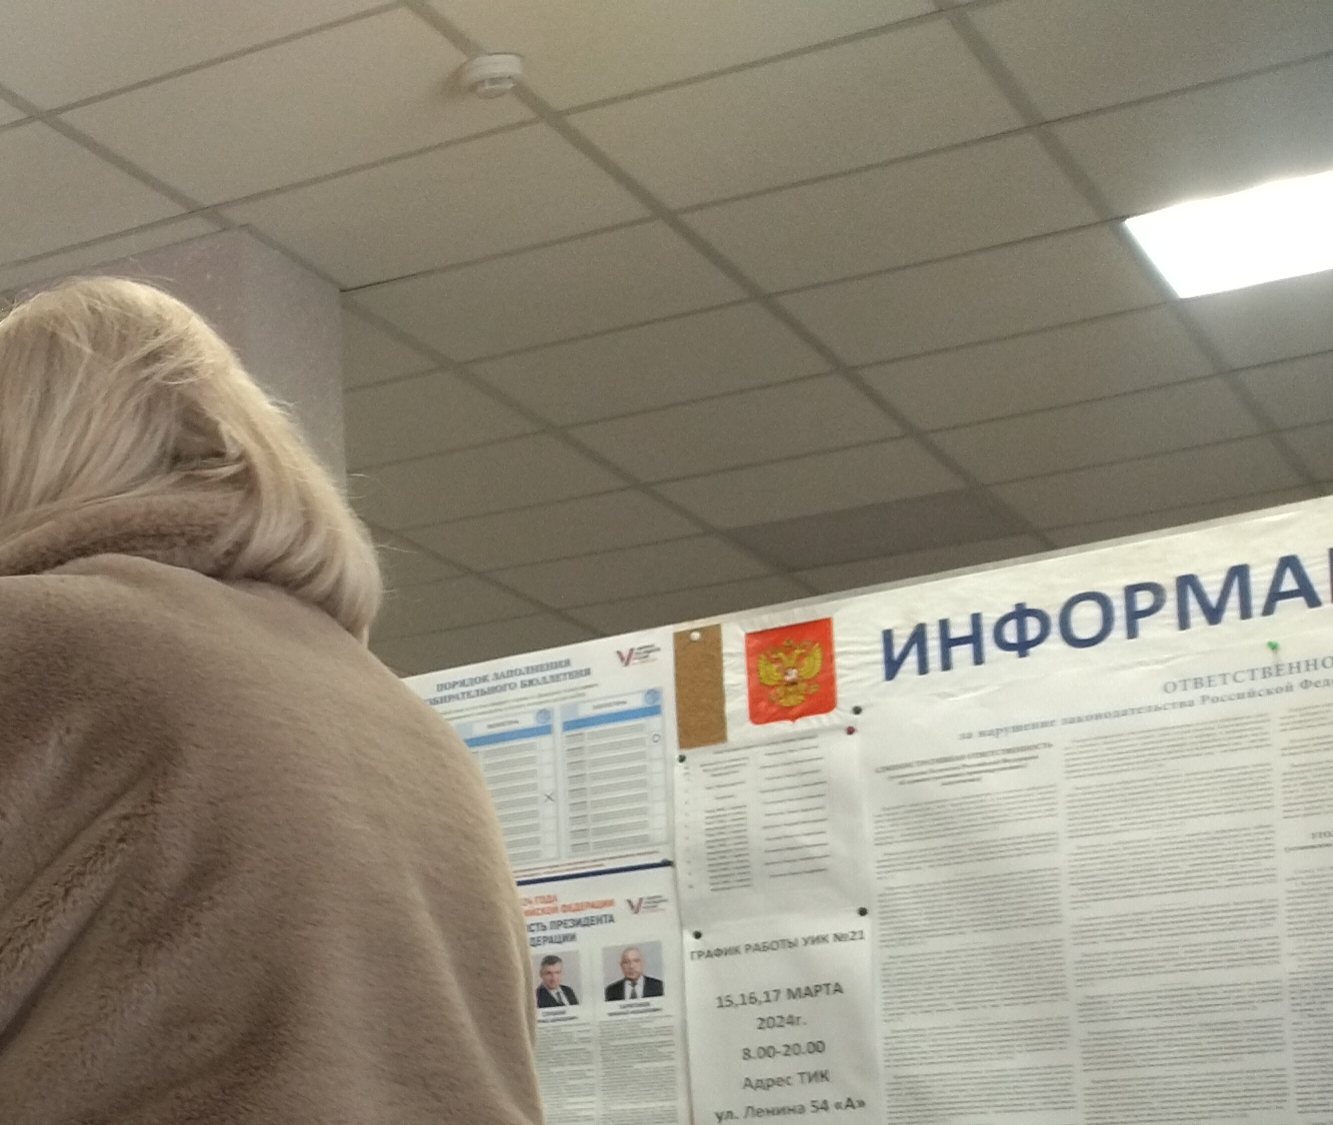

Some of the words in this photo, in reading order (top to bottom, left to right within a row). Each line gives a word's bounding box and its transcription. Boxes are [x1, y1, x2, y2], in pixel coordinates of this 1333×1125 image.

[882, 548, 1333, 682] ИНФОРМА
[436, 674, 490, 693] ПОРЯДОК
[492, 658, 572, 682] ЗАПОЛНЕНИЯ
[1199, 681, 1294, 706] Российской
[549, 913, 615, 931] ПРЕЗИДЕНТА
[689, 946, 742, 961] ГРАФИК
[744, 938, 800, 955] РАБОТЫ
[801, 933, 830, 947] УИК
[832, 929, 866, 944] №21
[715, 989, 782, 1010] 15,16,17
[786, 981, 845, 1001] МАРТА
[756, 1013, 808, 1031] 2024г.
[741, 1040, 826, 1061] 8.00-20.00
[742, 1075, 793, 1092] Адрес
[797, 1069, 831, 1084] ТИК
[714, 1109, 739, 1124] ул.
[743, 1104, 807, 1120] Ленина
[810, 1099, 830, 1114] 54
[834, 1097, 867, 1110] «А»
